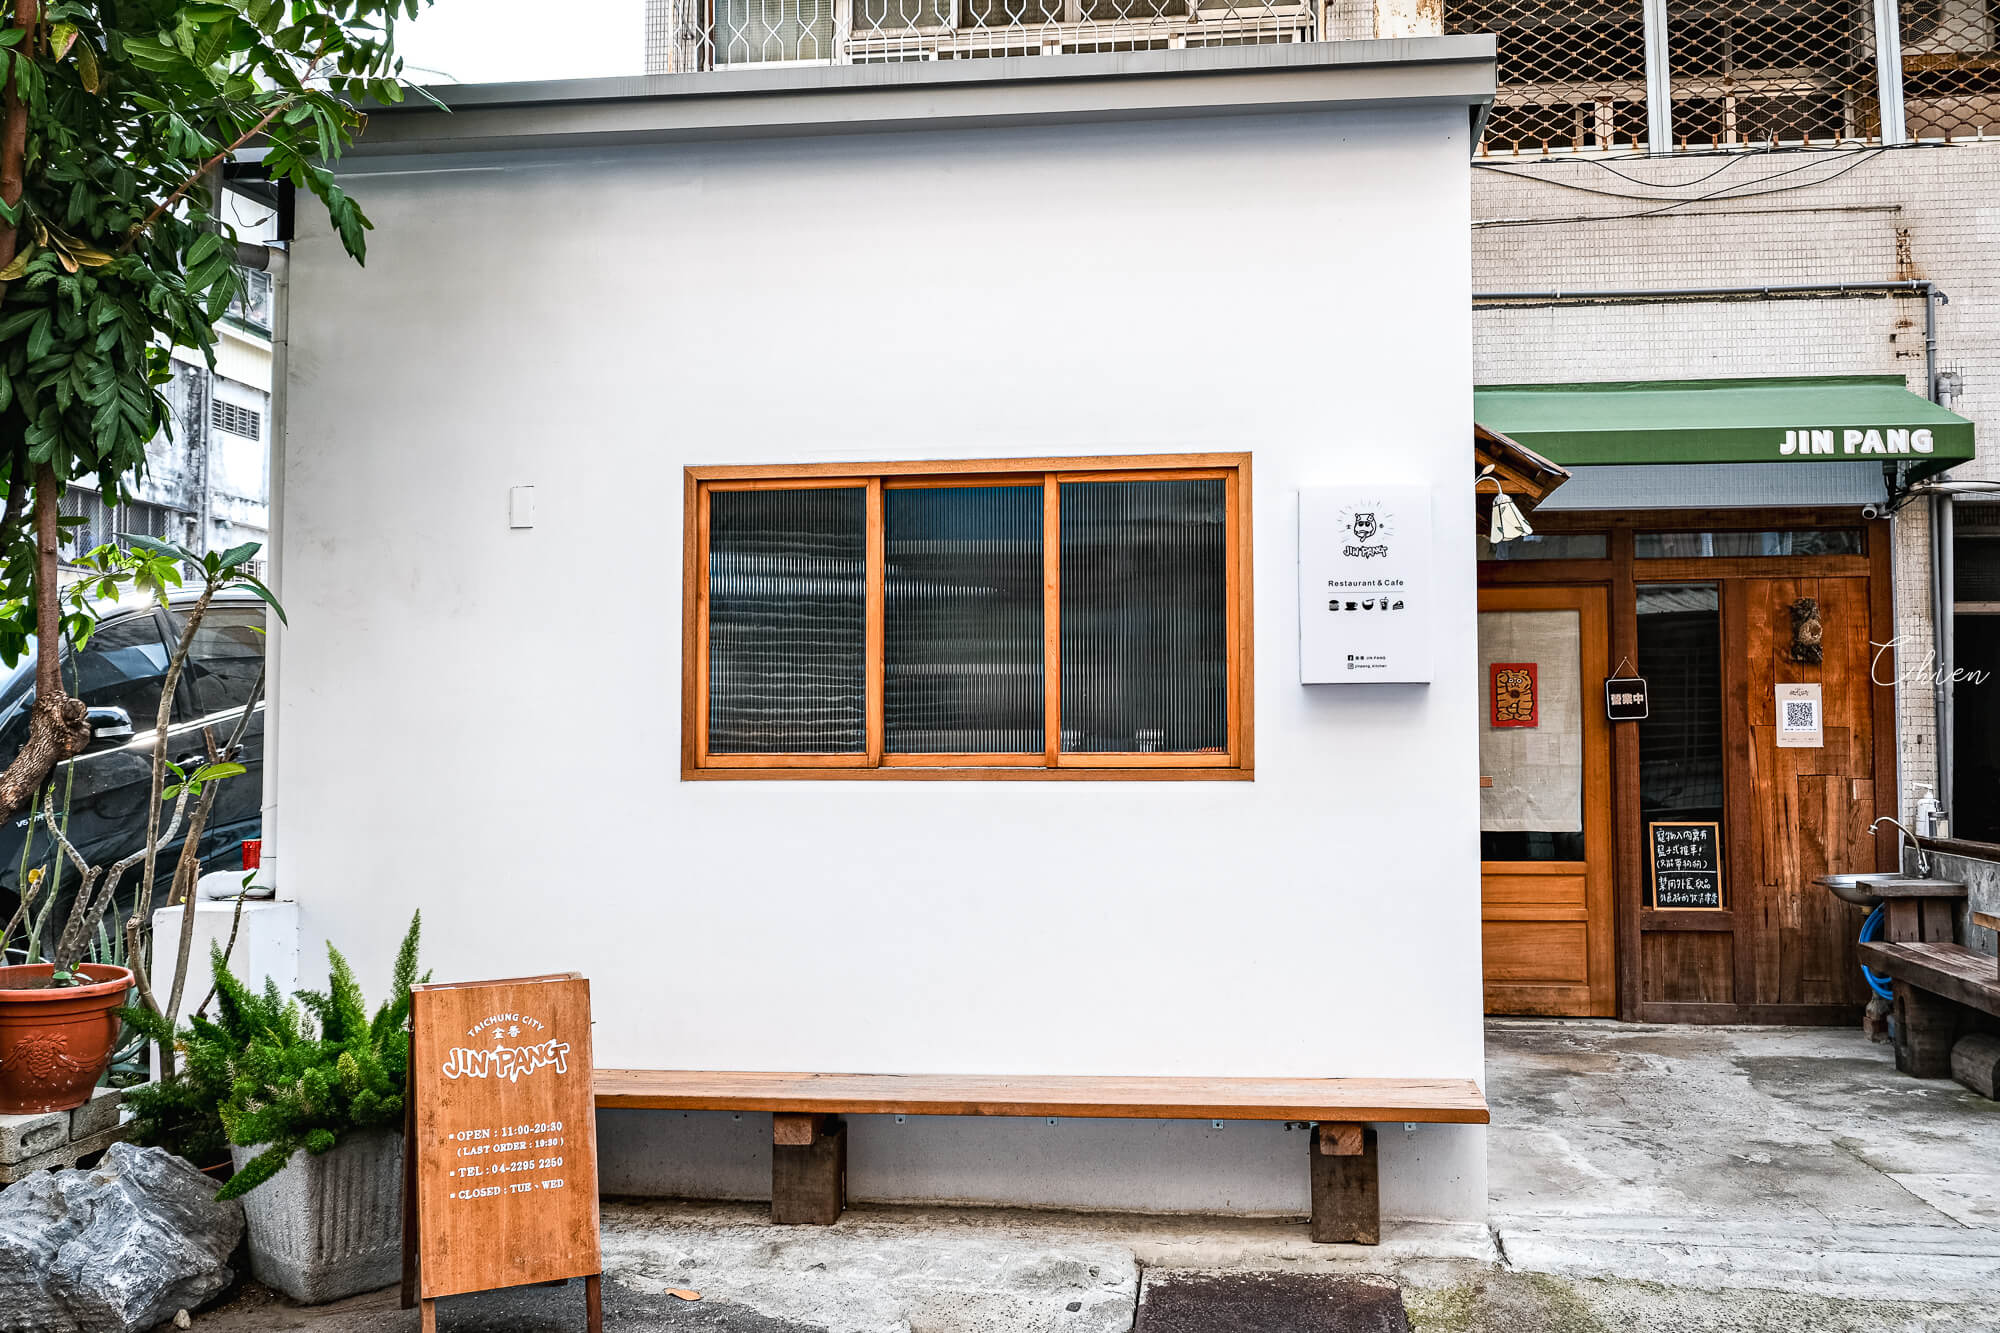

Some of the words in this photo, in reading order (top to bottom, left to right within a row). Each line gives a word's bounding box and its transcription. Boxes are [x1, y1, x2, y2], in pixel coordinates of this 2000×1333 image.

[1779, 430, 1834, 455] JIN
[1843, 428, 1934, 454] PANG
[467, 1013, 520, 1037] TAICHUNG
[522, 1015, 545, 1032] CITY
[442, 1047, 489, 1079] JIN
[490, 1039, 570, 1083] PANG
[456, 1129, 491, 1141] OPEN
[501, 1121, 563, 1137] 11:00-20:30
[492, 1141, 527, 1153] ORDER
[457, 1166, 483, 1178] TEL
[538, 1156, 563, 1169] 2250
[458, 1186, 501, 1200] CLOSED
[541, 1179, 564, 1190] WED
